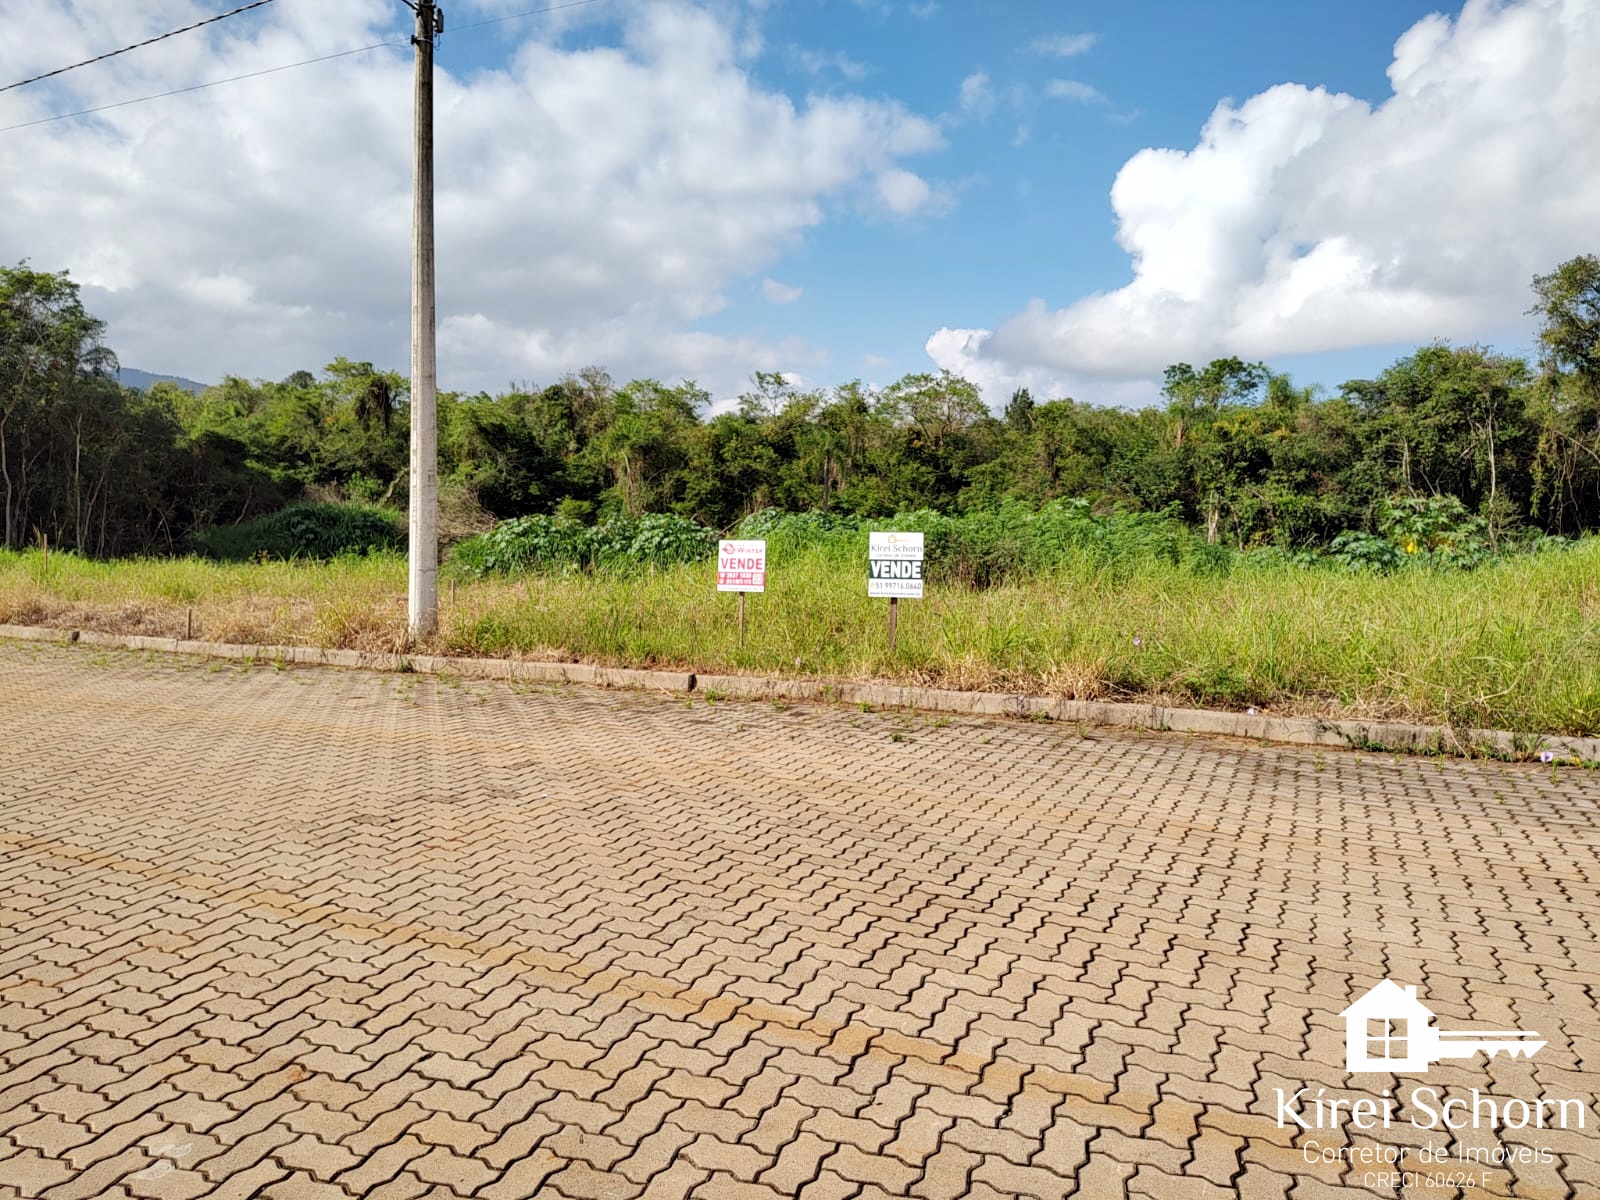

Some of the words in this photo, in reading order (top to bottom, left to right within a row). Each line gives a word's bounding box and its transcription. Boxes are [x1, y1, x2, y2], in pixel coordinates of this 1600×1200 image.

[893, 544, 922, 553] Schorn
[721, 558, 763, 570] VENDE
[870, 560, 922, 578] VENDE
